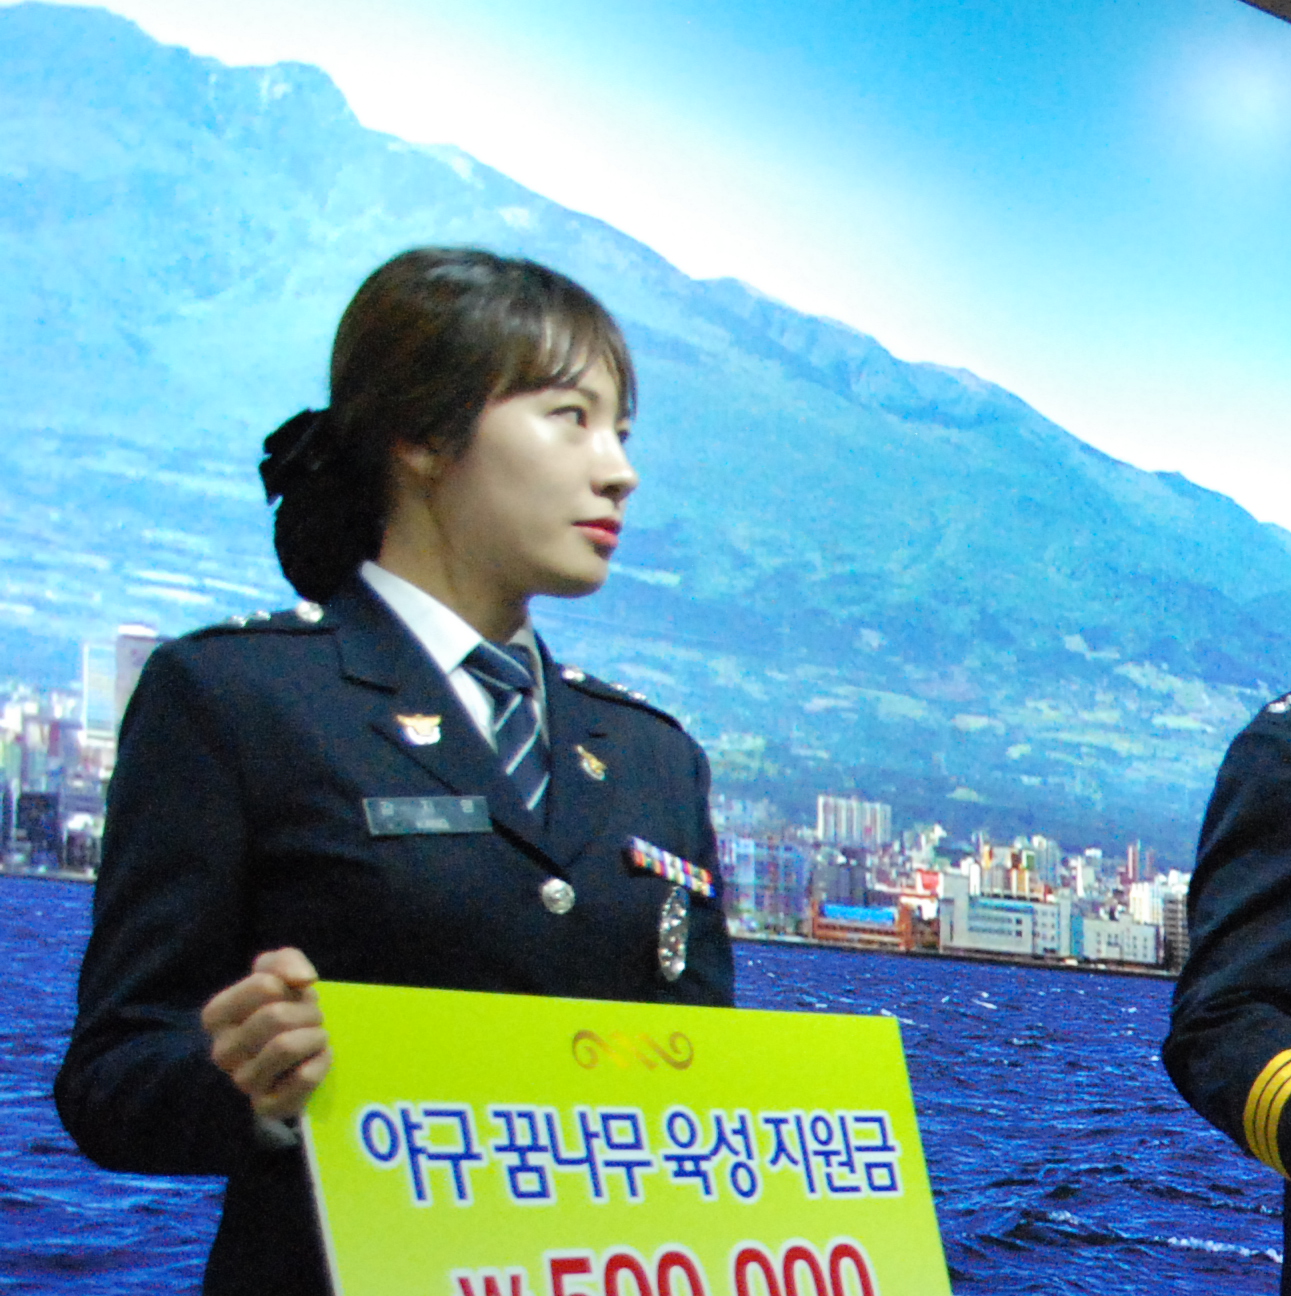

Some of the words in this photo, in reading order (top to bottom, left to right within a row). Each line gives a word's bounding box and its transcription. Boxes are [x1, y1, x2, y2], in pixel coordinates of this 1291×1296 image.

[359, 1107, 484, 1202] 야구
[491, 1109, 654, 1200] 꿈나무
[662, 1110, 759, 1200] 육성
[762, 1112, 900, 1196] 지원금
